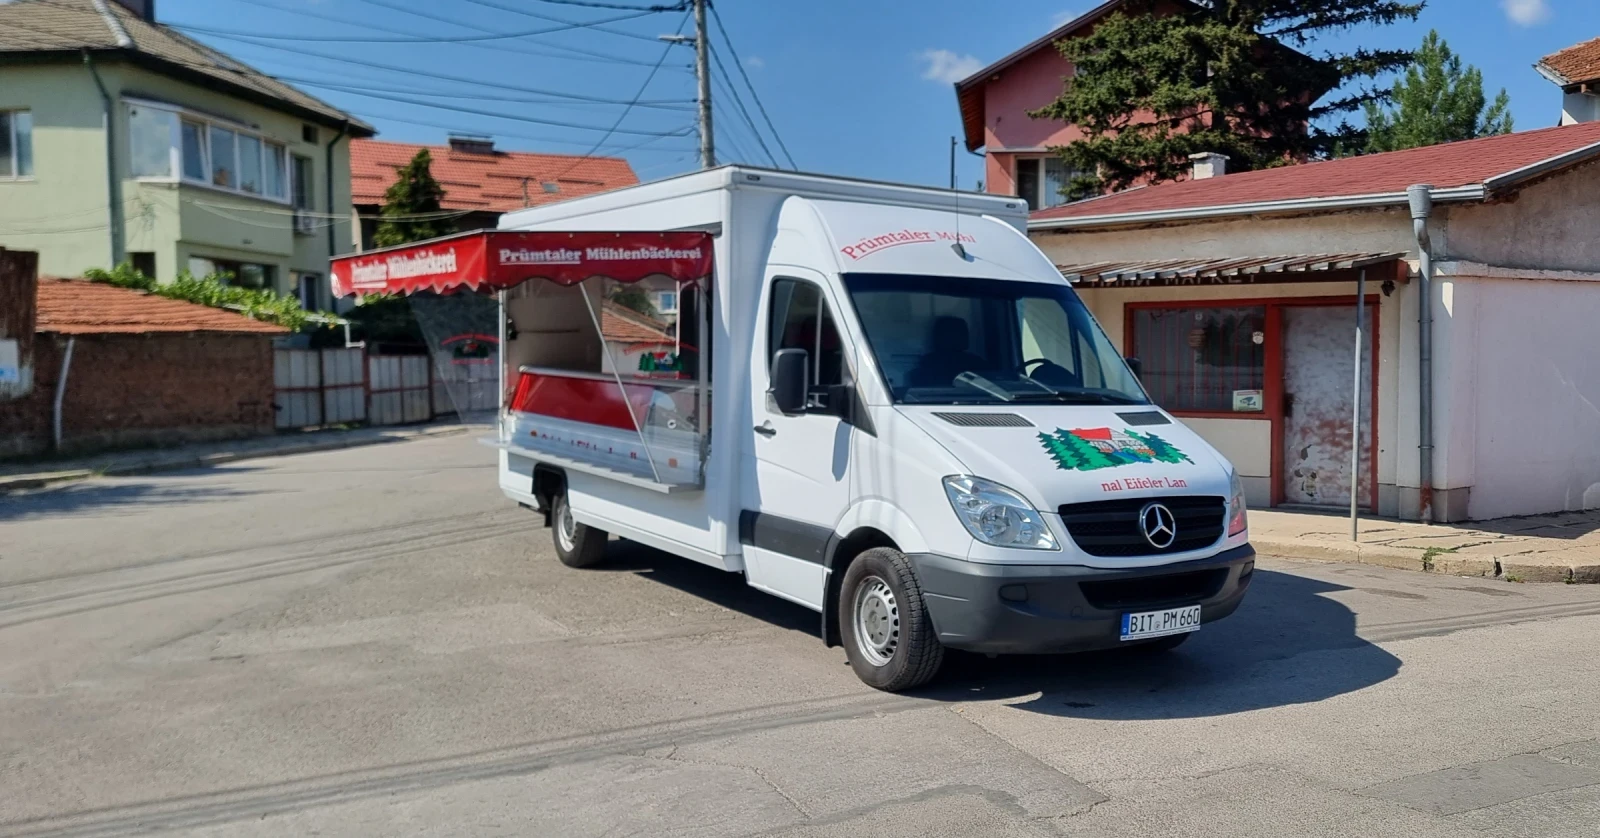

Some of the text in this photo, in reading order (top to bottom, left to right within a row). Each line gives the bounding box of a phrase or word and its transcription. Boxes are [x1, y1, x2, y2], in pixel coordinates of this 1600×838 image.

[841, 229, 931, 259] Prümtaler
[499, 247, 702, 263] Prümtaler Mühlenbäckerei
[1101, 476, 1188, 492] nal Eifeler Lan
[1130, 614, 1154, 633] BIT
